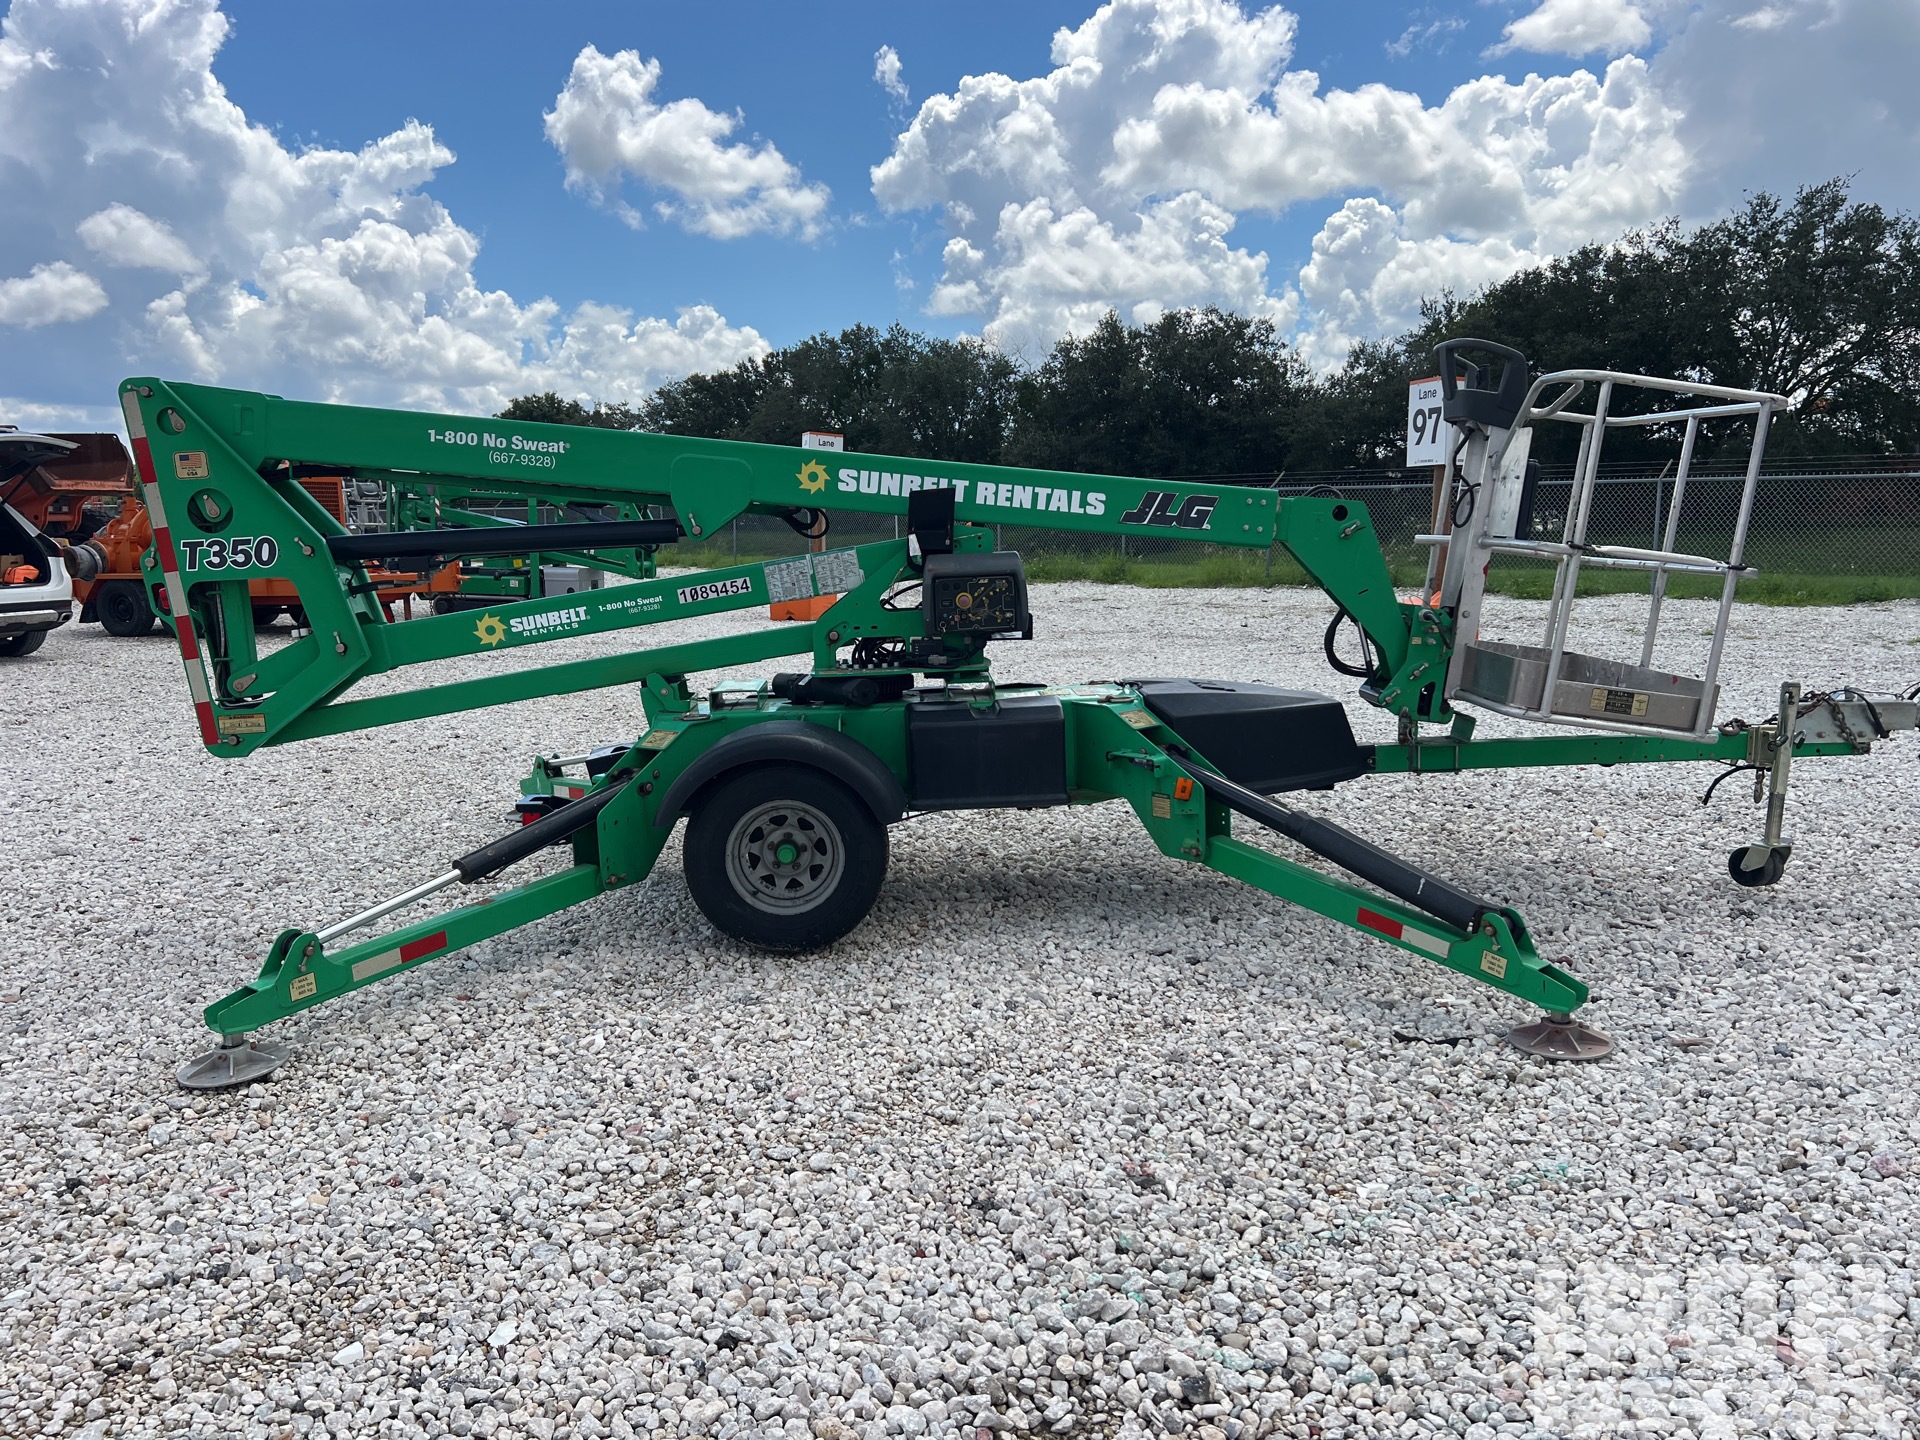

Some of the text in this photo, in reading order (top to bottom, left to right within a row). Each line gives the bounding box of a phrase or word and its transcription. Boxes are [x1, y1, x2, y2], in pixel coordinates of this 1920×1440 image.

[1418, 388, 1437, 400] Lane
[1412, 406, 1442, 446] 97
[428, 429, 478, 446] 1-800
[482, 433, 507, 448] No
[818, 438, 835, 447] Lane
[488, 450, 556, 470] (667-9328)
[975, 481, 1106, 516] RENTALS
[1119, 490, 1221, 530] JLG
[180, 535, 279, 572] T350
[679, 578, 751, 603] 1089454
[598, 595, 663, 612] 1-800 No Sweat
[628, 603, 661, 615] (667-9328)
[523, 622, 579, 637] RENTALS
